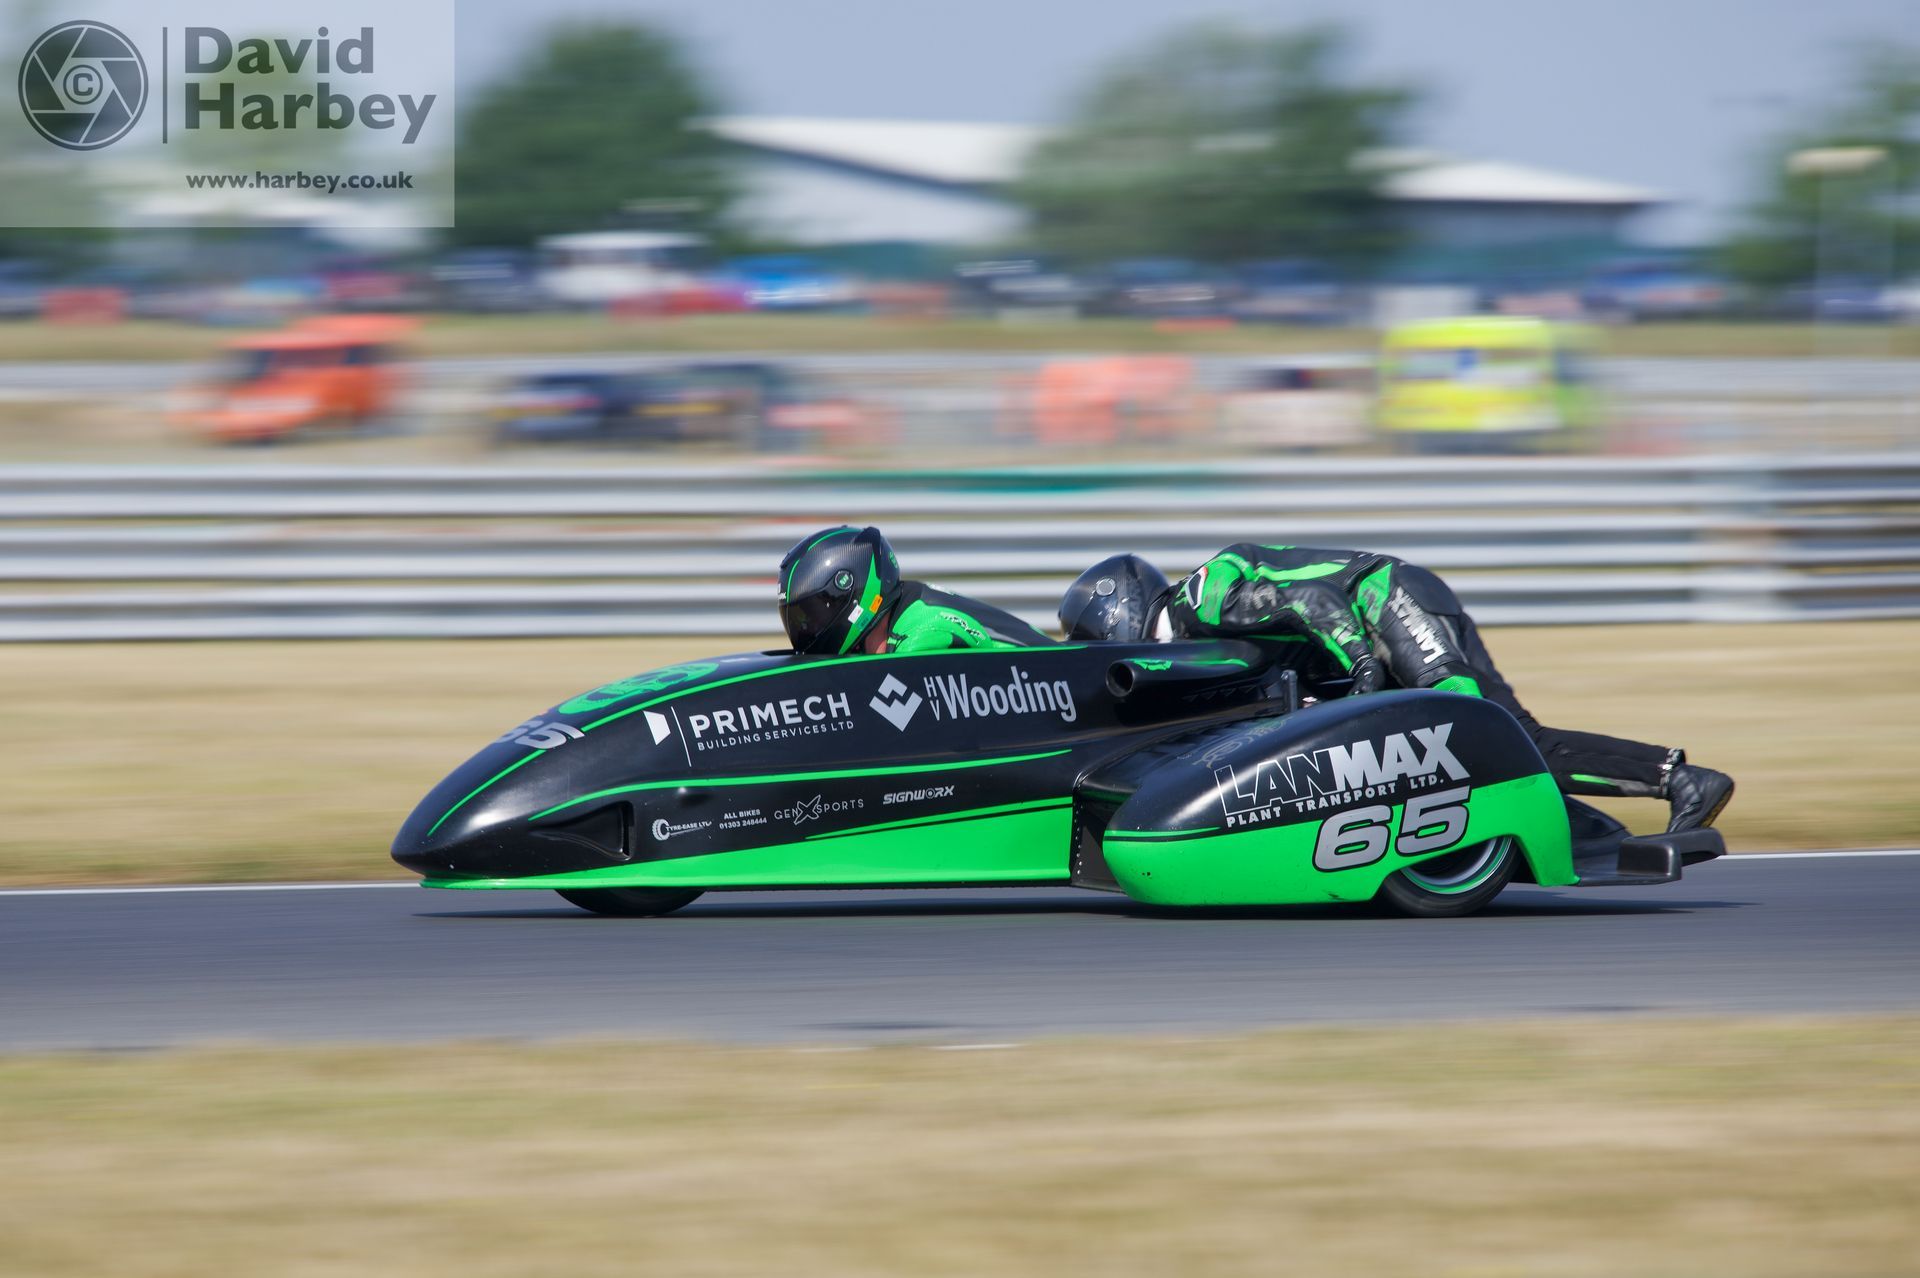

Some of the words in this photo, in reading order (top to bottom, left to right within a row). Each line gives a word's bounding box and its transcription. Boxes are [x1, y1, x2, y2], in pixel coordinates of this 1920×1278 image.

[688, 692, 851, 739] PRIMECH
[935, 665, 1077, 723] Wooding
[697, 733, 761, 751] BUILDING
[764, 723, 827, 741] SERVICES
[831, 720, 854, 732] LTD
[1214, 722, 1471, 817] LANMAX
[719, 821, 741, 830] 01303
[739, 808, 761, 818] BIKES
[1226, 806, 1282, 828] PLANT
[1296, 782, 1396, 813] TRANSPORT
[1409, 774, 1445, 790] LTD.
[1312, 785, 1472, 873] 65
